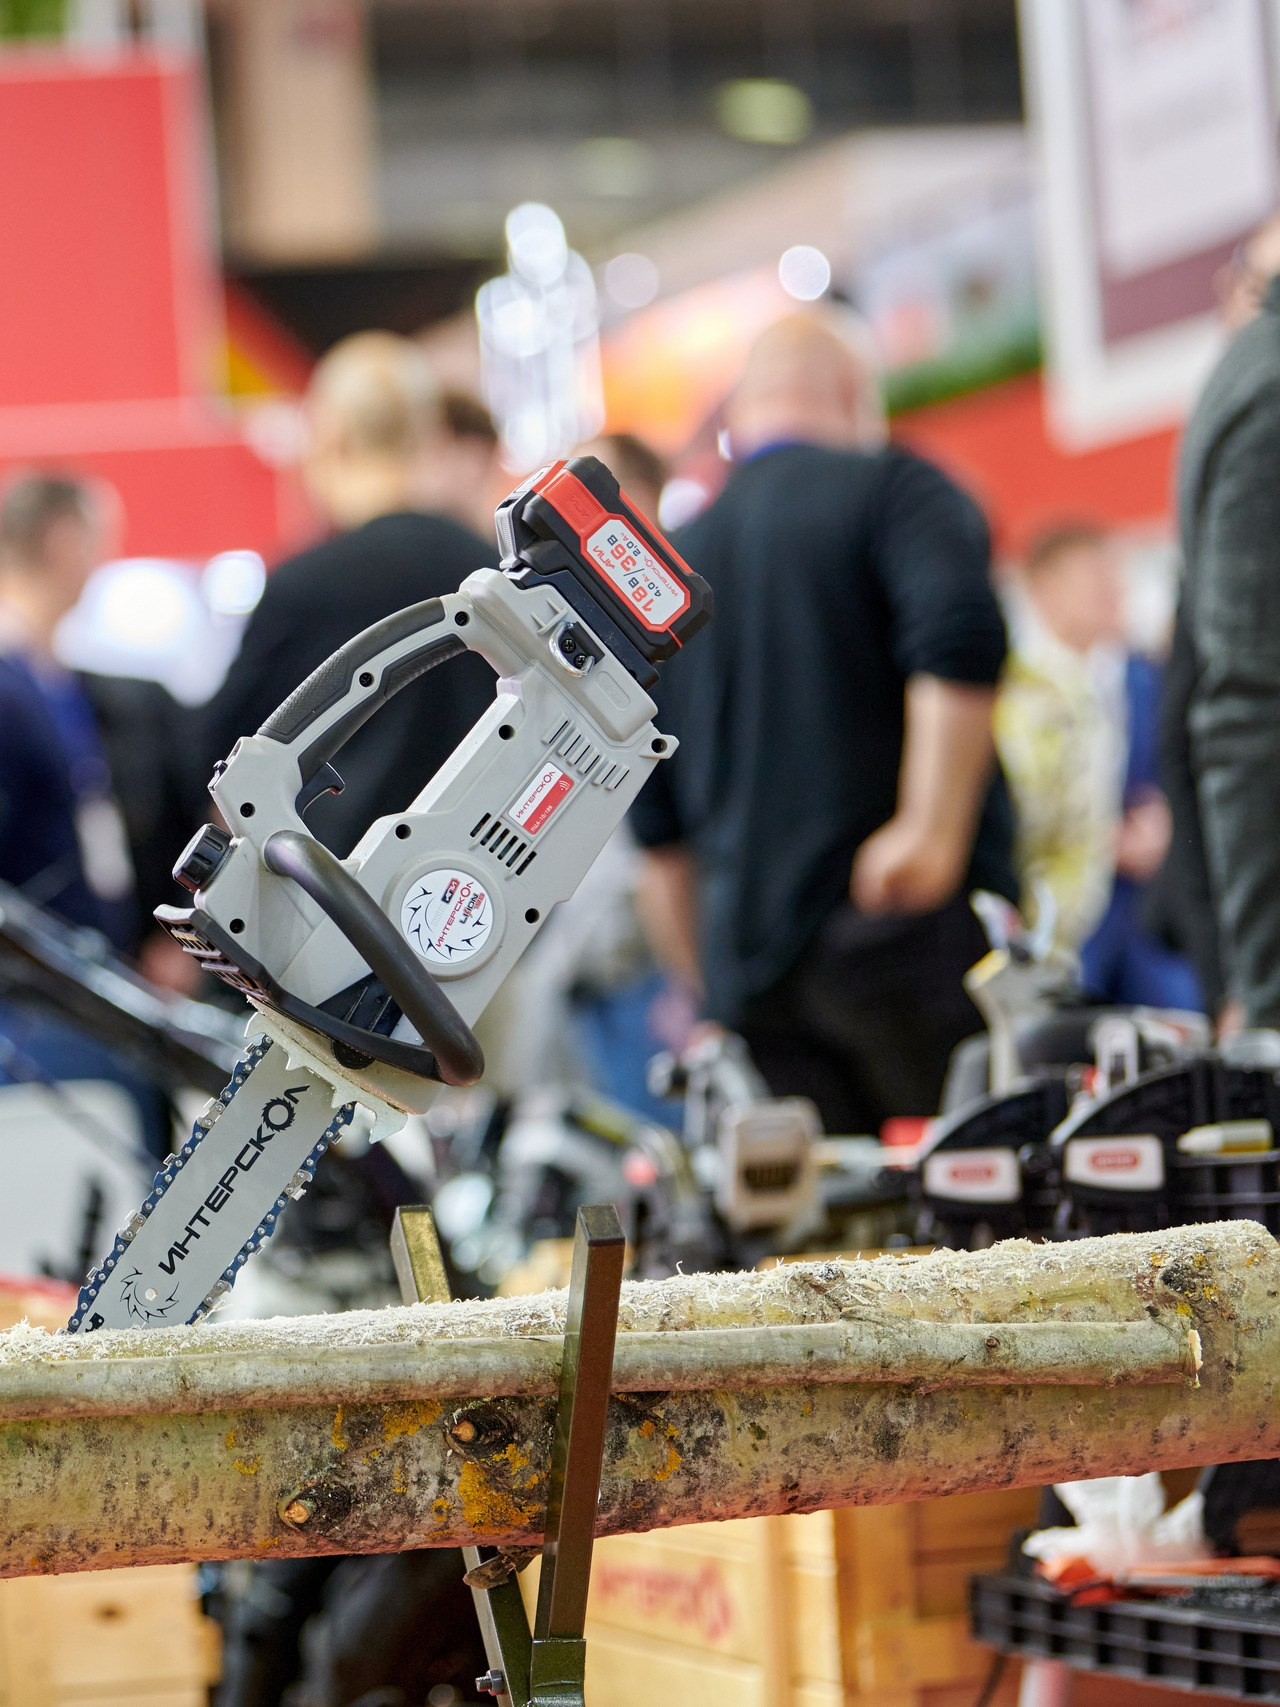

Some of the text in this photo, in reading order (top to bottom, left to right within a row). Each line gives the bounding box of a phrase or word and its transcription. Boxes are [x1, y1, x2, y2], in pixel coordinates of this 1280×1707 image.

[626, 541, 641, 556] 2,0
[644, 556, 678, 596] ИНТЕРСКОЛ
[516, 772, 556, 818] ИНТЕРСКОЛ
[436, 882, 474, 948] ИНТЕРСКОЛ
[158, 1085, 310, 1276] ИНТЕРСКОЛ
